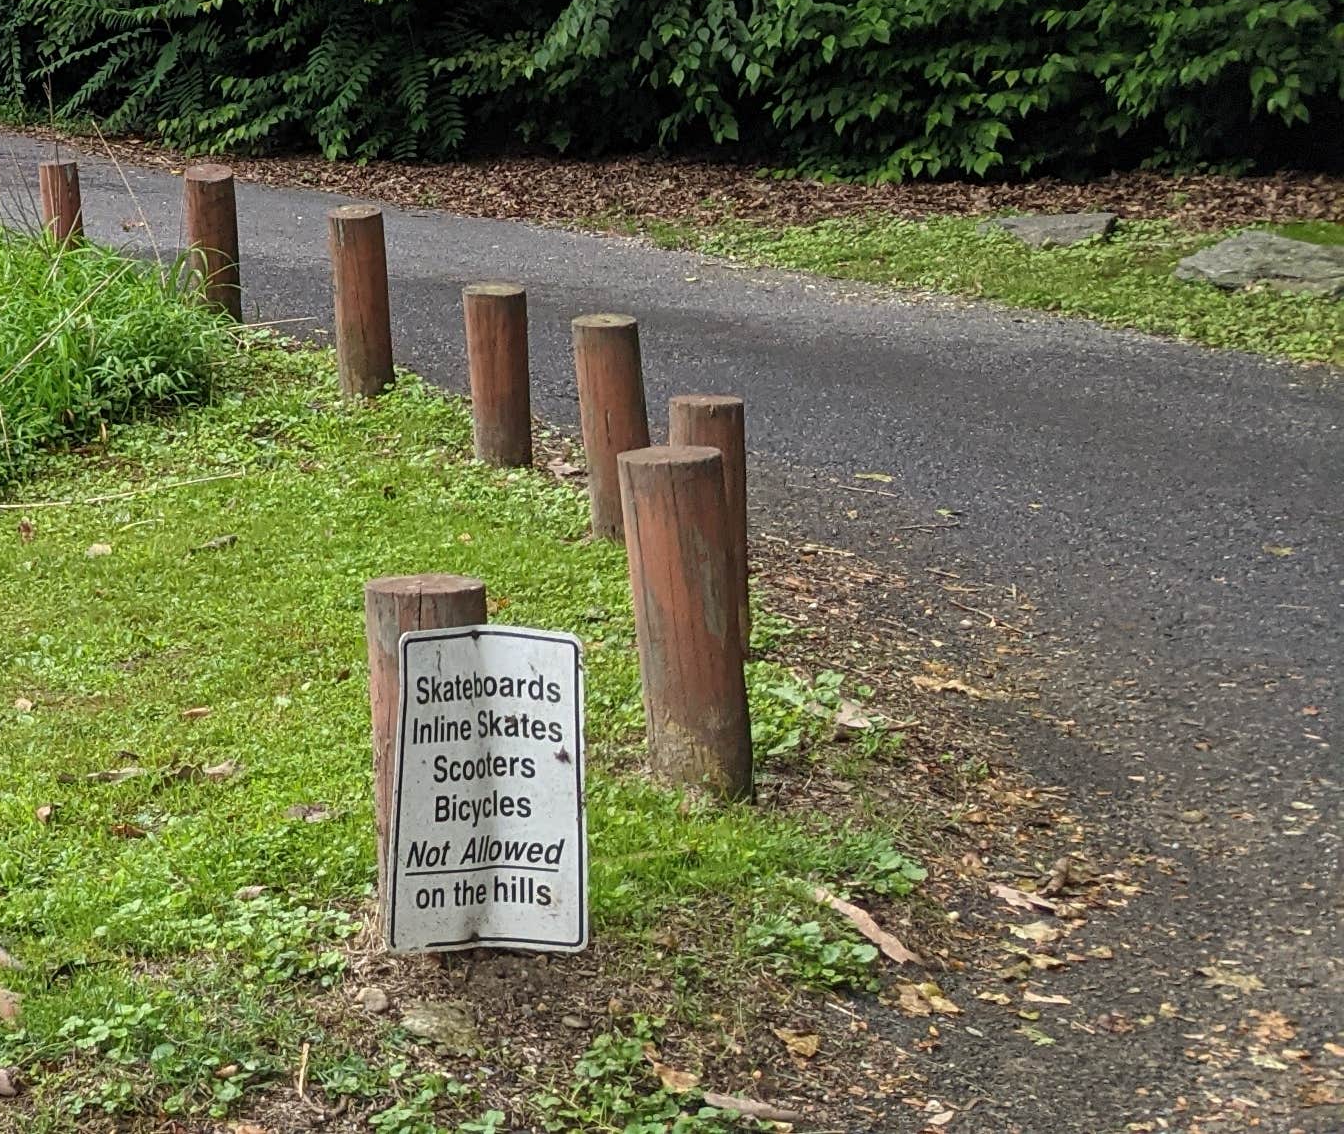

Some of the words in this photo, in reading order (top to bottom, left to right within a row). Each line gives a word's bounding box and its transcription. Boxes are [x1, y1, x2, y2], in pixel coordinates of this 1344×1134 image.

[416, 672, 561, 705] Skateboards
[412, 715, 472, 745] Inline
[478, 709, 563, 744] Skates
[433, 752, 536, 784] Scooters
[435, 790, 532, 828] Bicycles
[406, 840, 451, 868] Not
[460, 835, 565, 866] Allowed
[416, 887, 445, 910] on
[454, 875, 487, 907] the
[494, 875, 552, 906] hills
